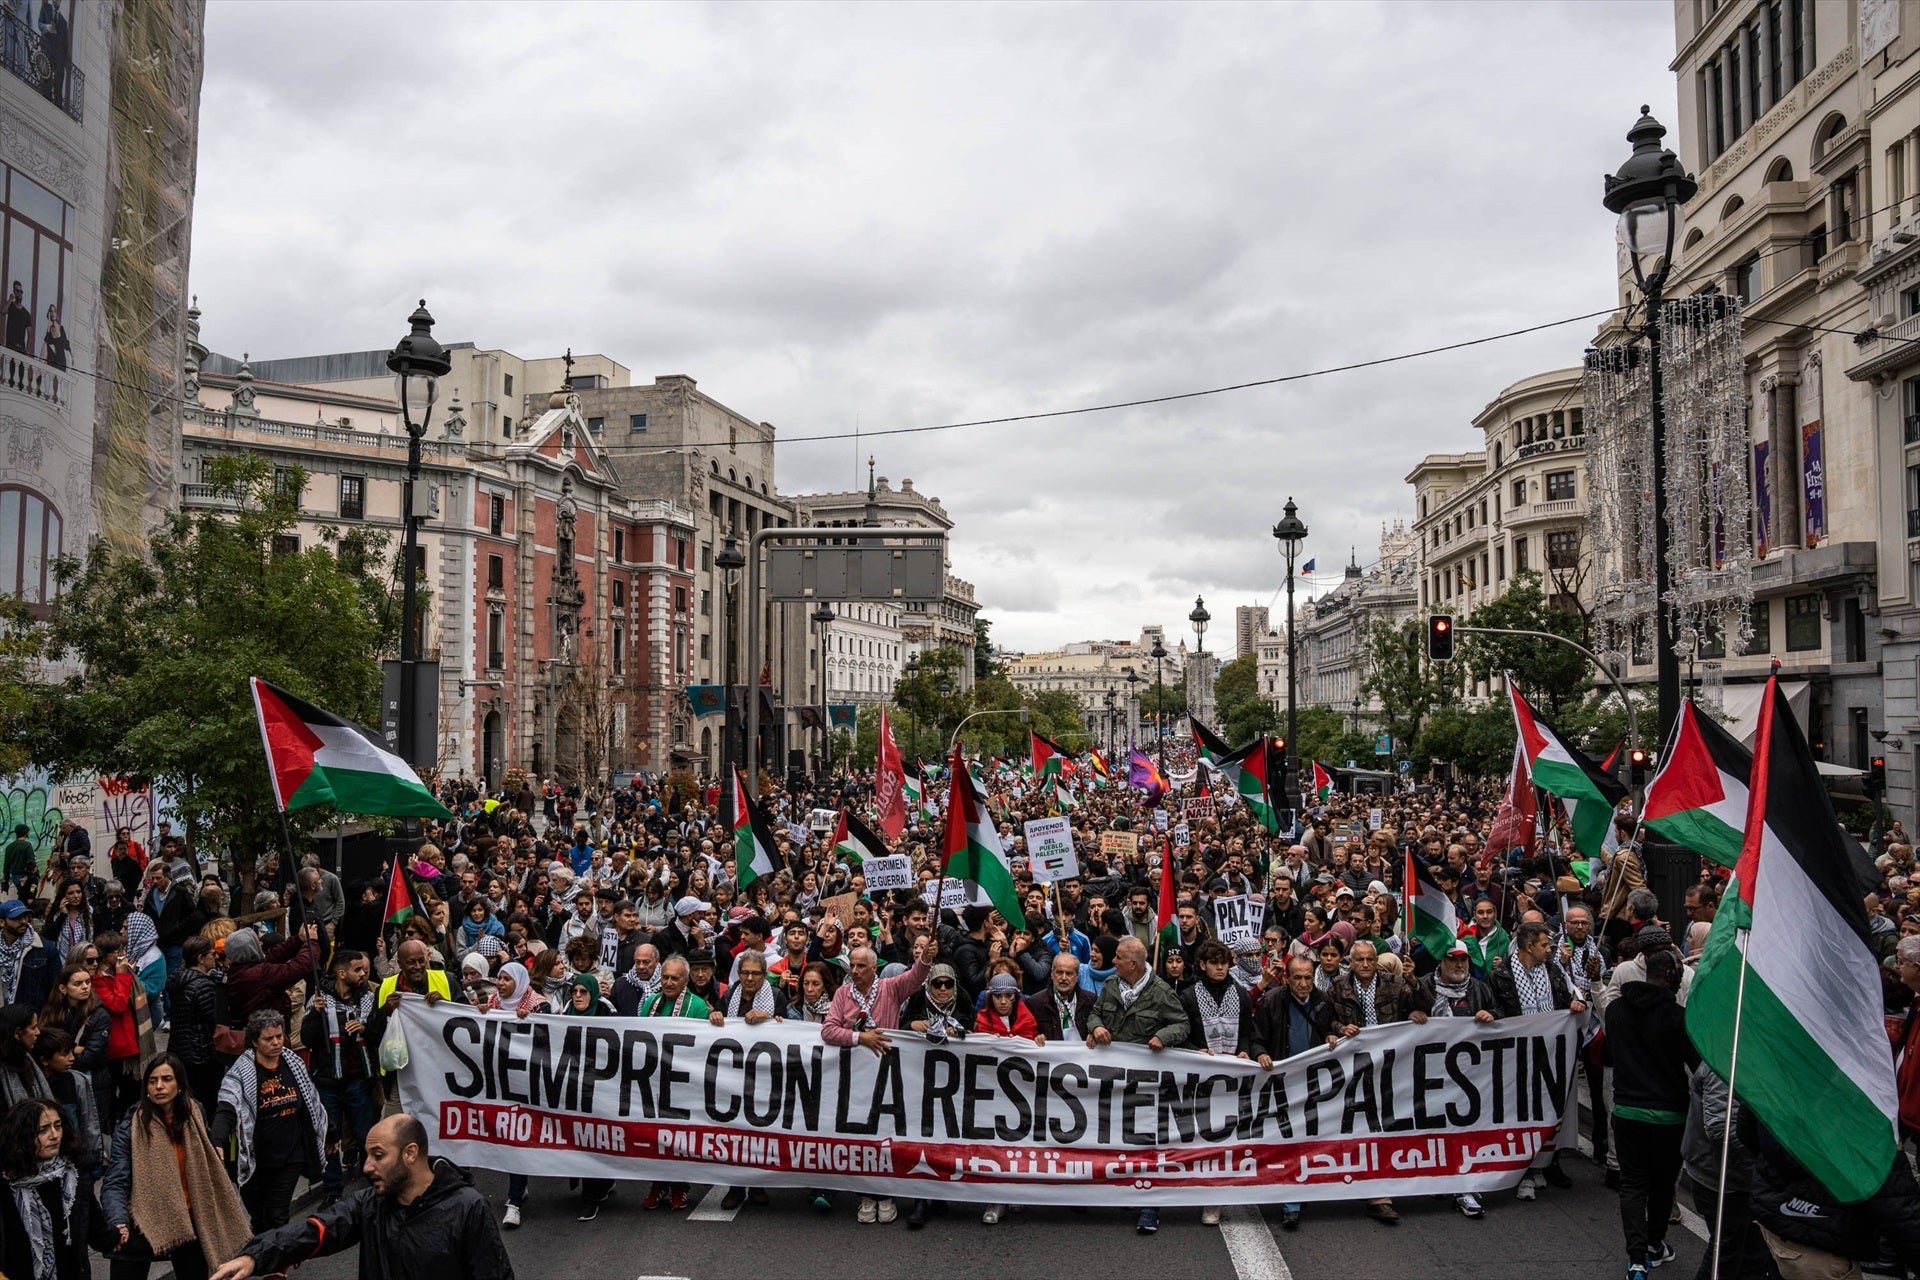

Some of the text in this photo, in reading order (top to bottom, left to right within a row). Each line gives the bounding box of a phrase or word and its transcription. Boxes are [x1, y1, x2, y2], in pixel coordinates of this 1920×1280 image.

[1183, 797, 1213, 808] ISRAEL
[1186, 808, 1213, 820] NAZI
[1030, 822, 1064, 833] APOYEMOS
[1176, 832, 1189, 845] PAZ
[1036, 848, 1069, 858] PALESTINO
[1040, 843, 1063, 851] PUEBLO
[867, 877, 877, 888] DE
[878, 875, 908, 886] GUERRA!
[941, 879, 964, 891] CRIME
[1217, 898, 1248, 930] PAZ
[603, 932, 618, 941] USTA
[1222, 930, 1250, 943] JUSTA
[602, 945, 616, 967] AZ
[442, 1016, 1579, 1146] SIEMPRE CON LA RESISTENCIA PALESTIN
[496, 1106, 532, 1142] RÍO
[540, 1116, 567, 1145] AL
[573, 1121, 625, 1152] MAR
[657, 1129, 780, 1167] PALESTINA
[789, 1137, 894, 1173] VENCERÁ
[950, 1150, 1093, 1182] ستنتصر
[1105, 1148, 1257, 1190] فلسطين
[1296, 1142, 1379, 1184] البحر
[1788, 1197, 1820, 1216] NIKE
